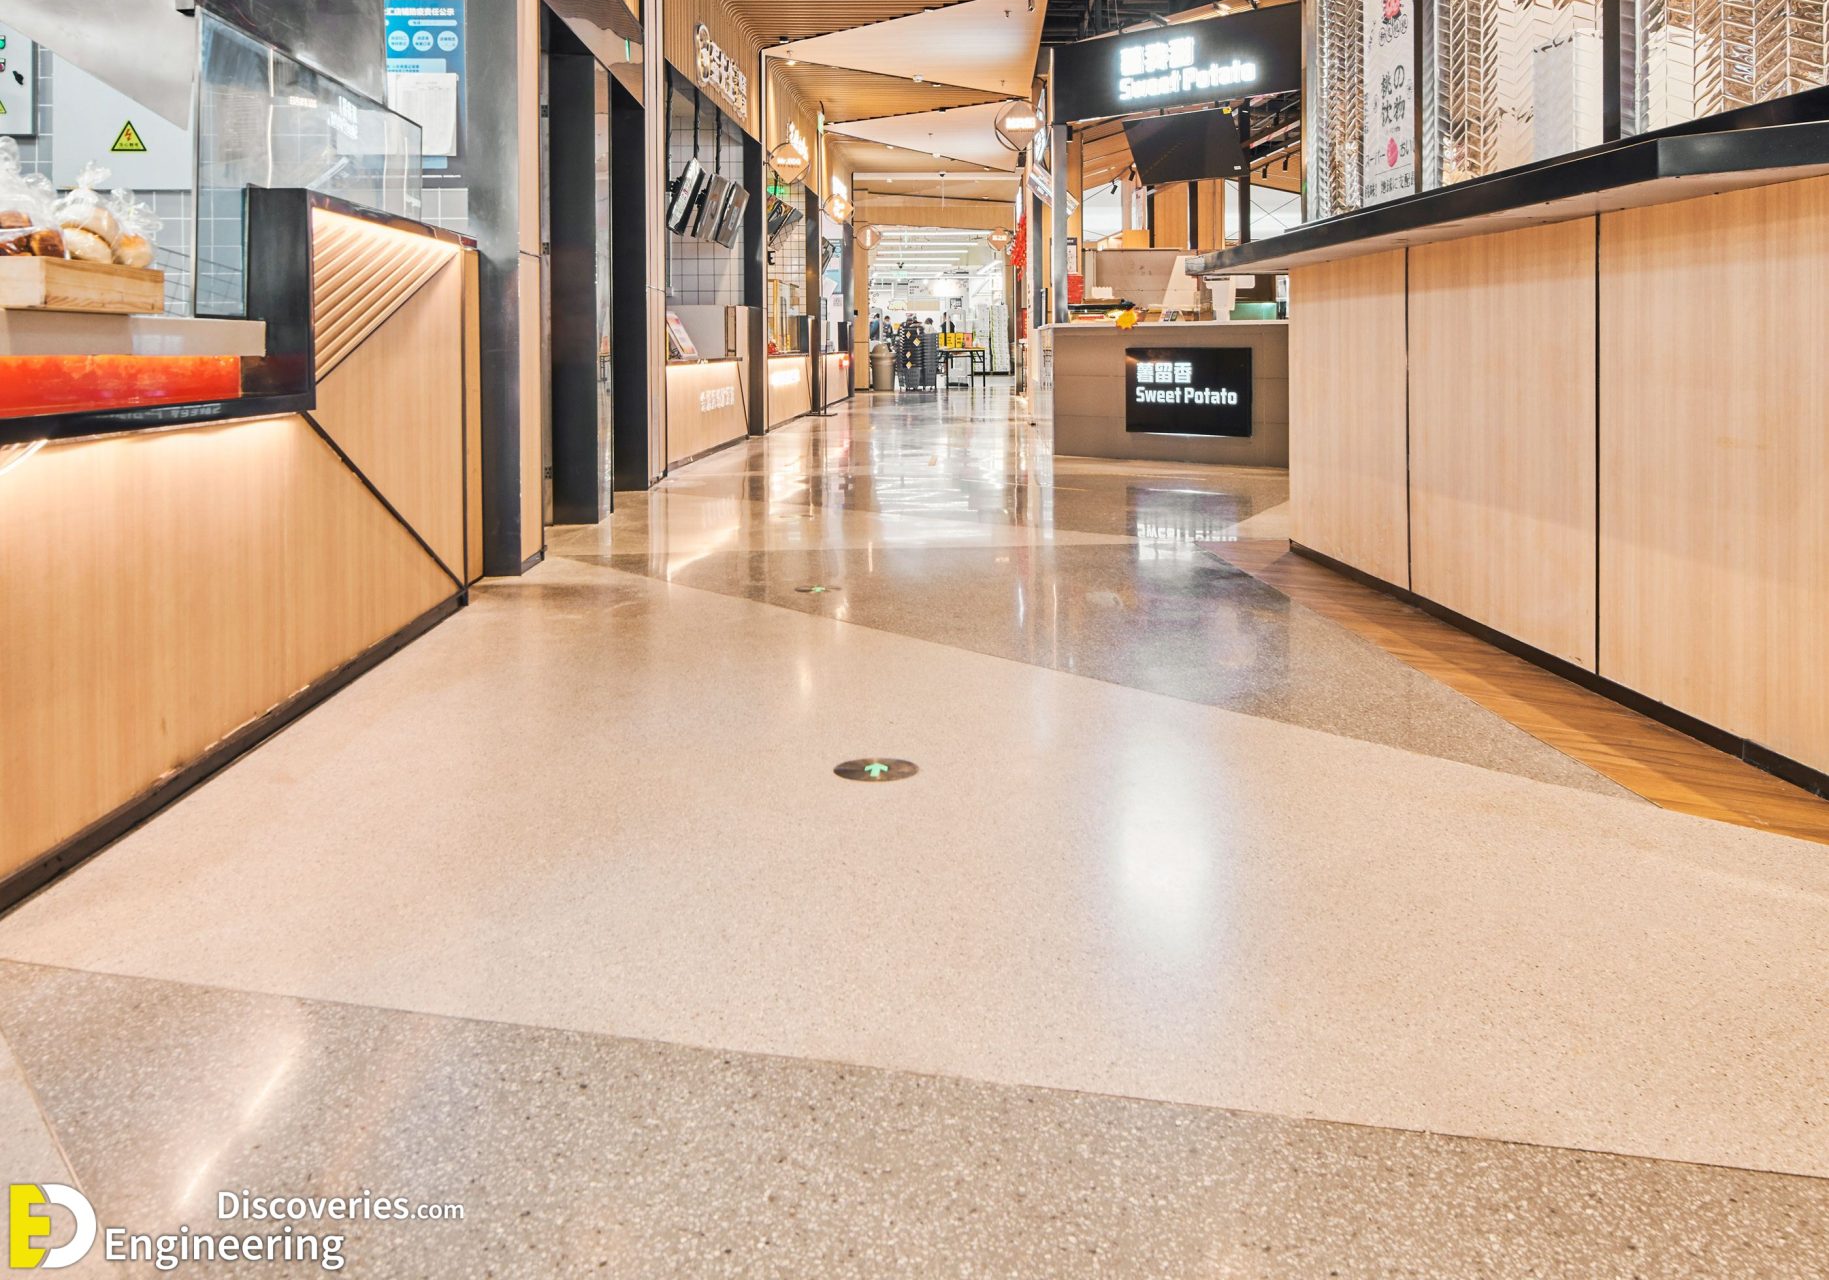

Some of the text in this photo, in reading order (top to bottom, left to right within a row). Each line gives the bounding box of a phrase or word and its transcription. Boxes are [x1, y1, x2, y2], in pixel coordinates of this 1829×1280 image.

[1119, 60, 1256, 100] Sweet Potato
[1136, 362, 1192, 384] 薯留香
[1136, 386, 1238, 405] Sweet Potato
